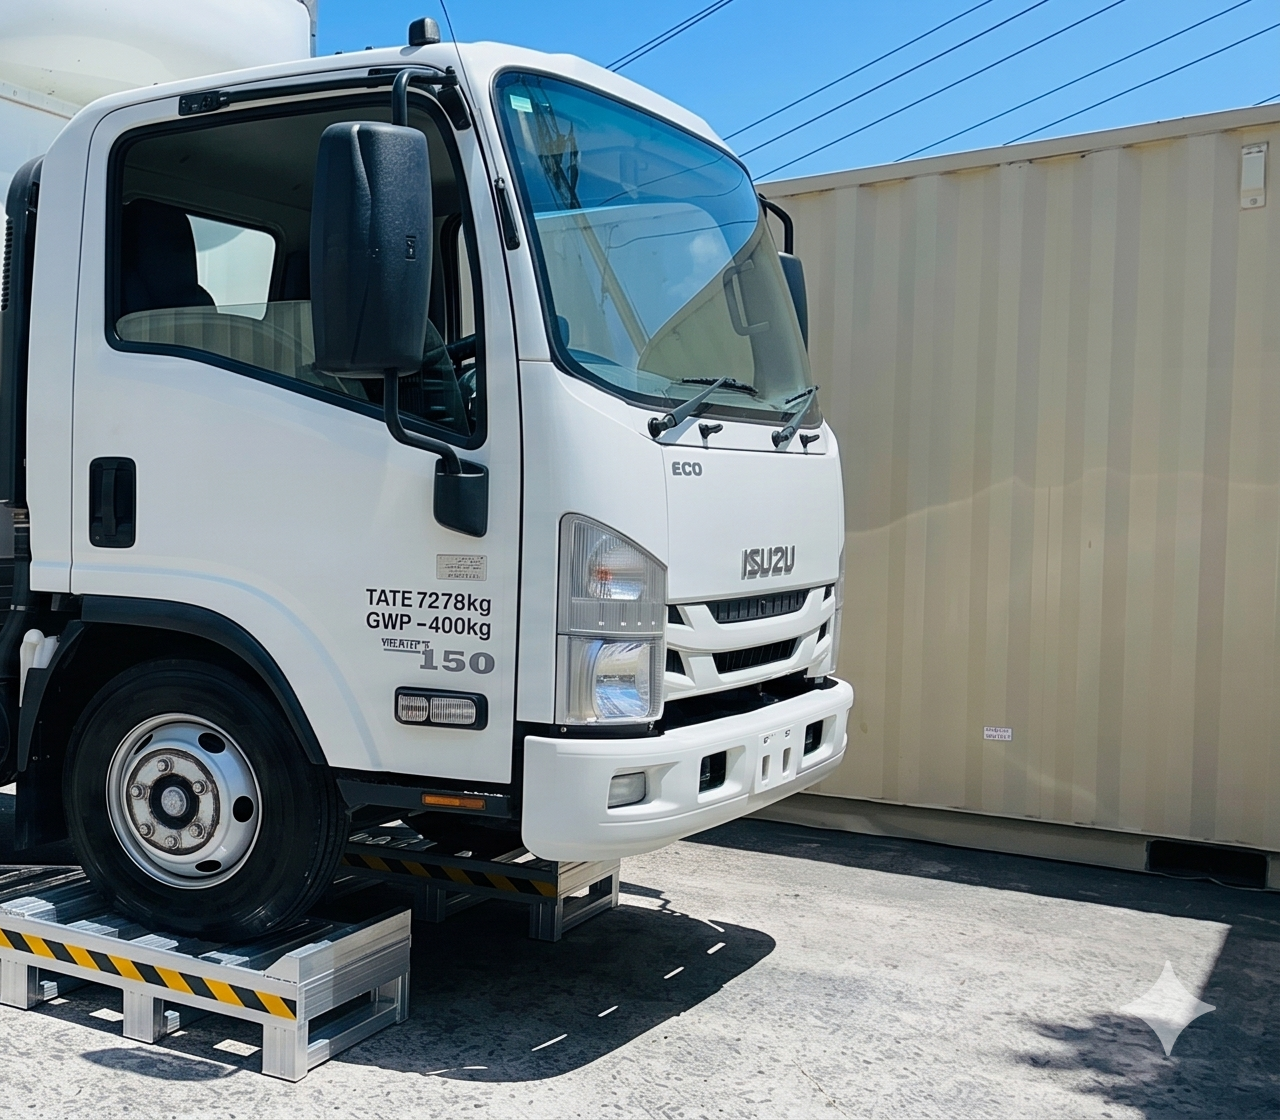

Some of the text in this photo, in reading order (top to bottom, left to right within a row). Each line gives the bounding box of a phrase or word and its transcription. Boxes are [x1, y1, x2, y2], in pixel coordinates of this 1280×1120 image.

[671, 461, 703, 477] ECO
[366, 588, 492, 617] TATE 7278kg
[366, 611, 412, 631] GWP
[419, 648, 496, 675] 150
